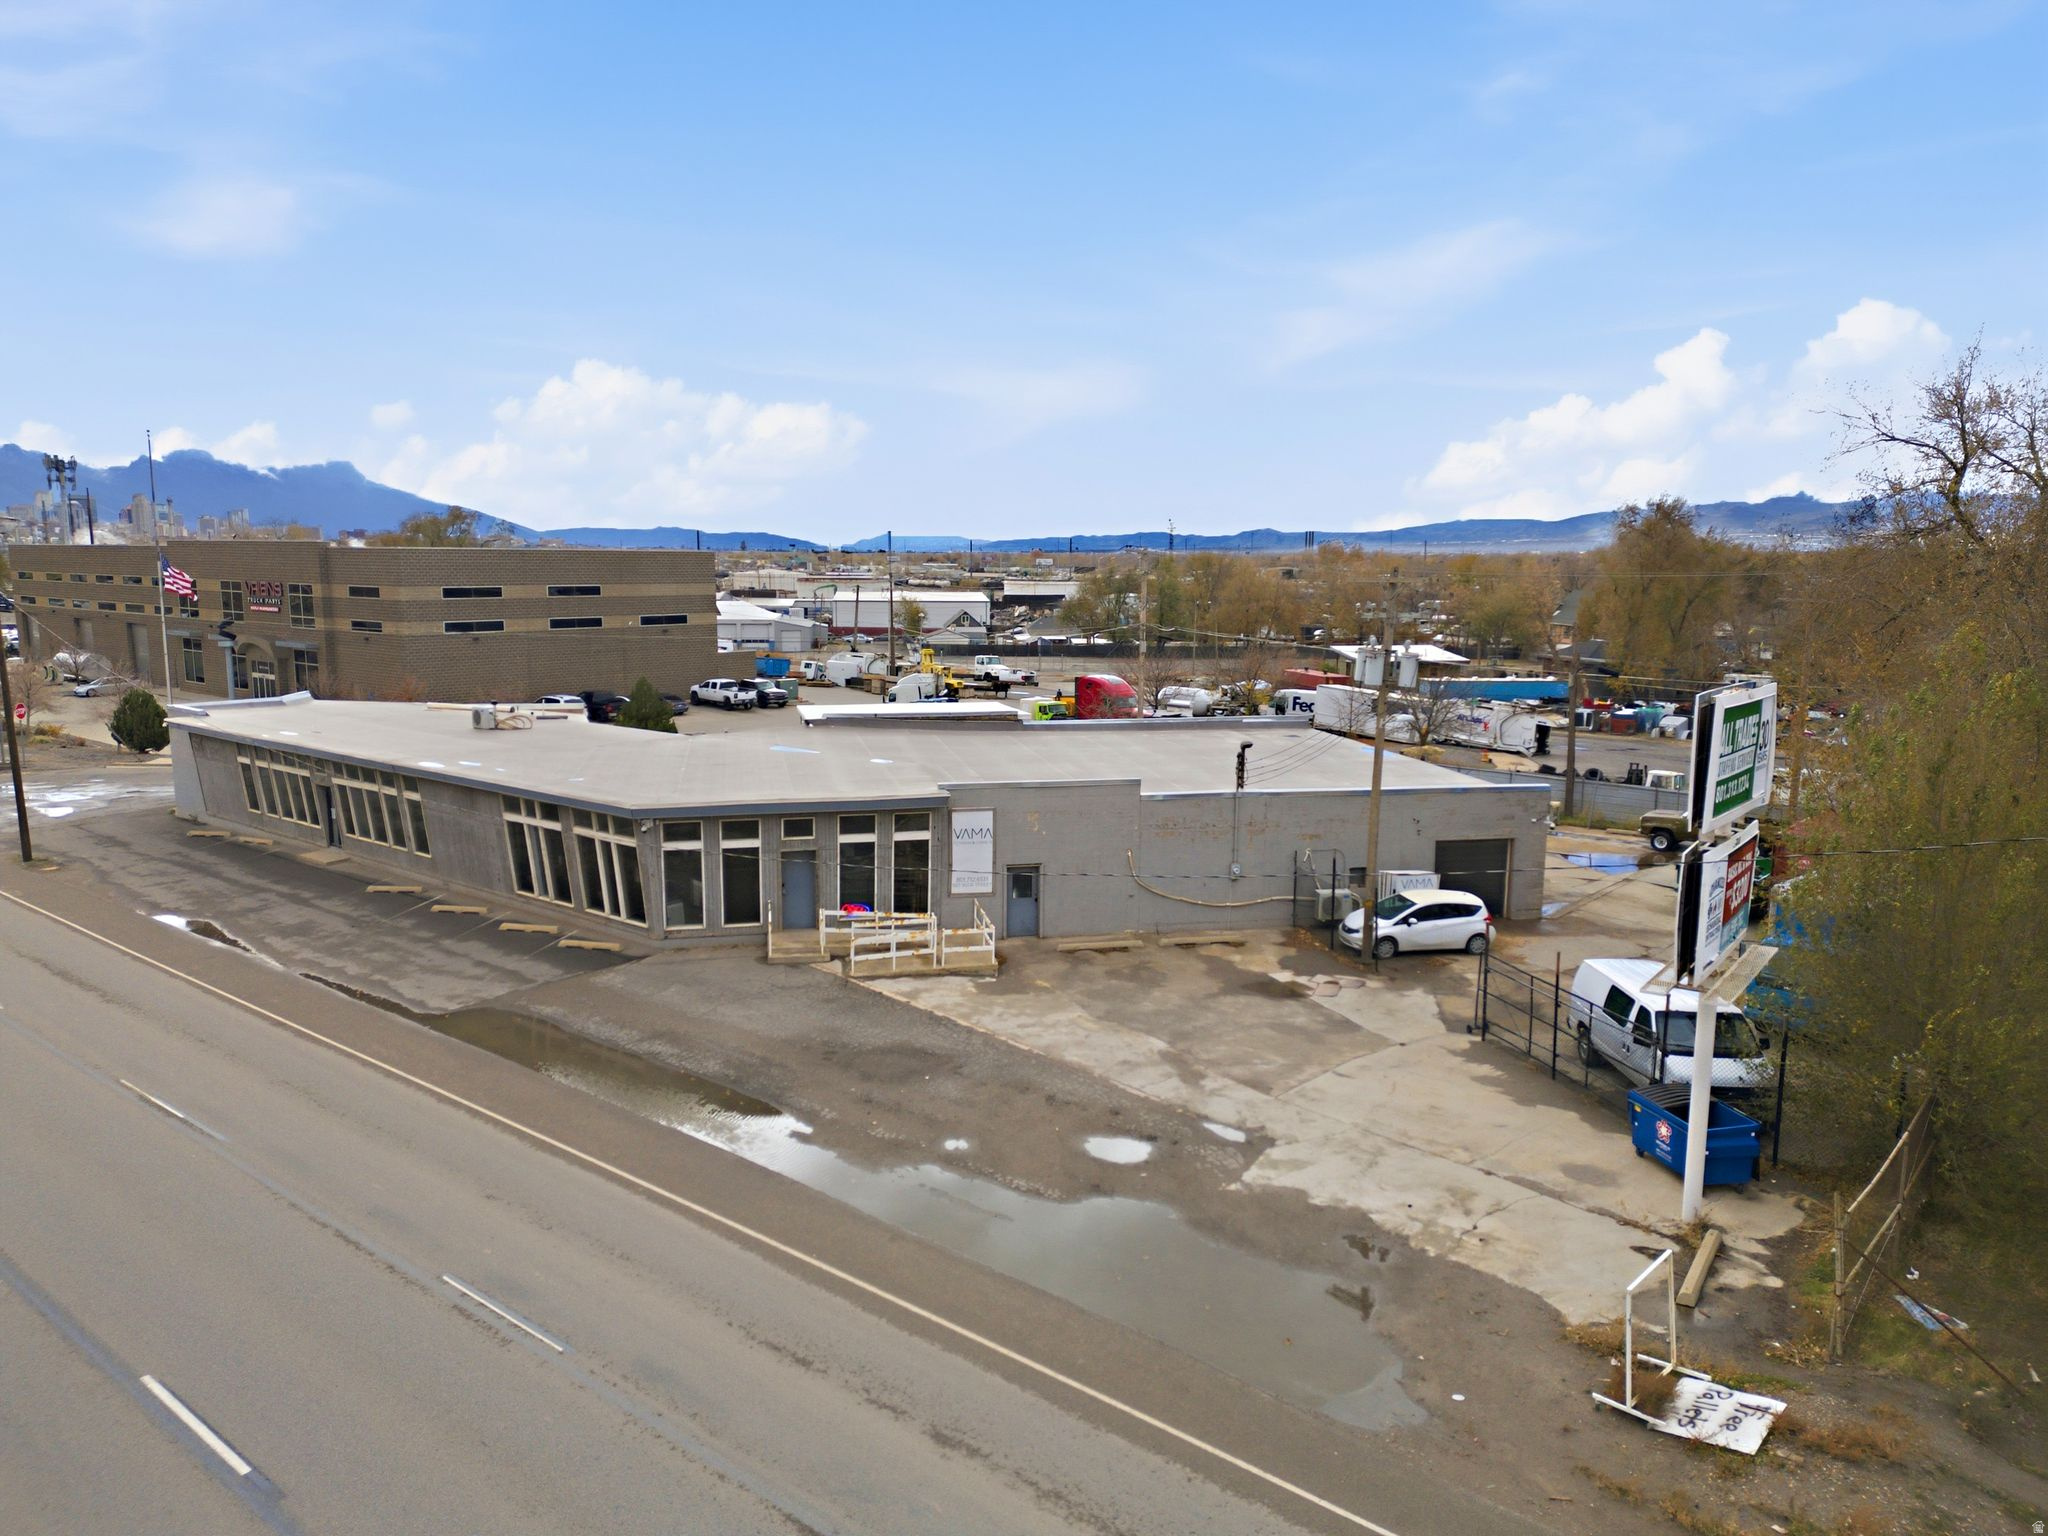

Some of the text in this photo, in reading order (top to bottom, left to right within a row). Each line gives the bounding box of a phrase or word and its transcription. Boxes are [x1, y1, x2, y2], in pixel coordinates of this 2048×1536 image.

[1720, 713, 1760, 756] ALL TRADES
[1759, 719, 1770, 751] 30
[953, 828, 993, 839] VAMA
[1401, 878, 1434, 889] VAMA
[1678, 1387, 1733, 1428] Pallets
[1720, 1401, 1775, 1432] Free
